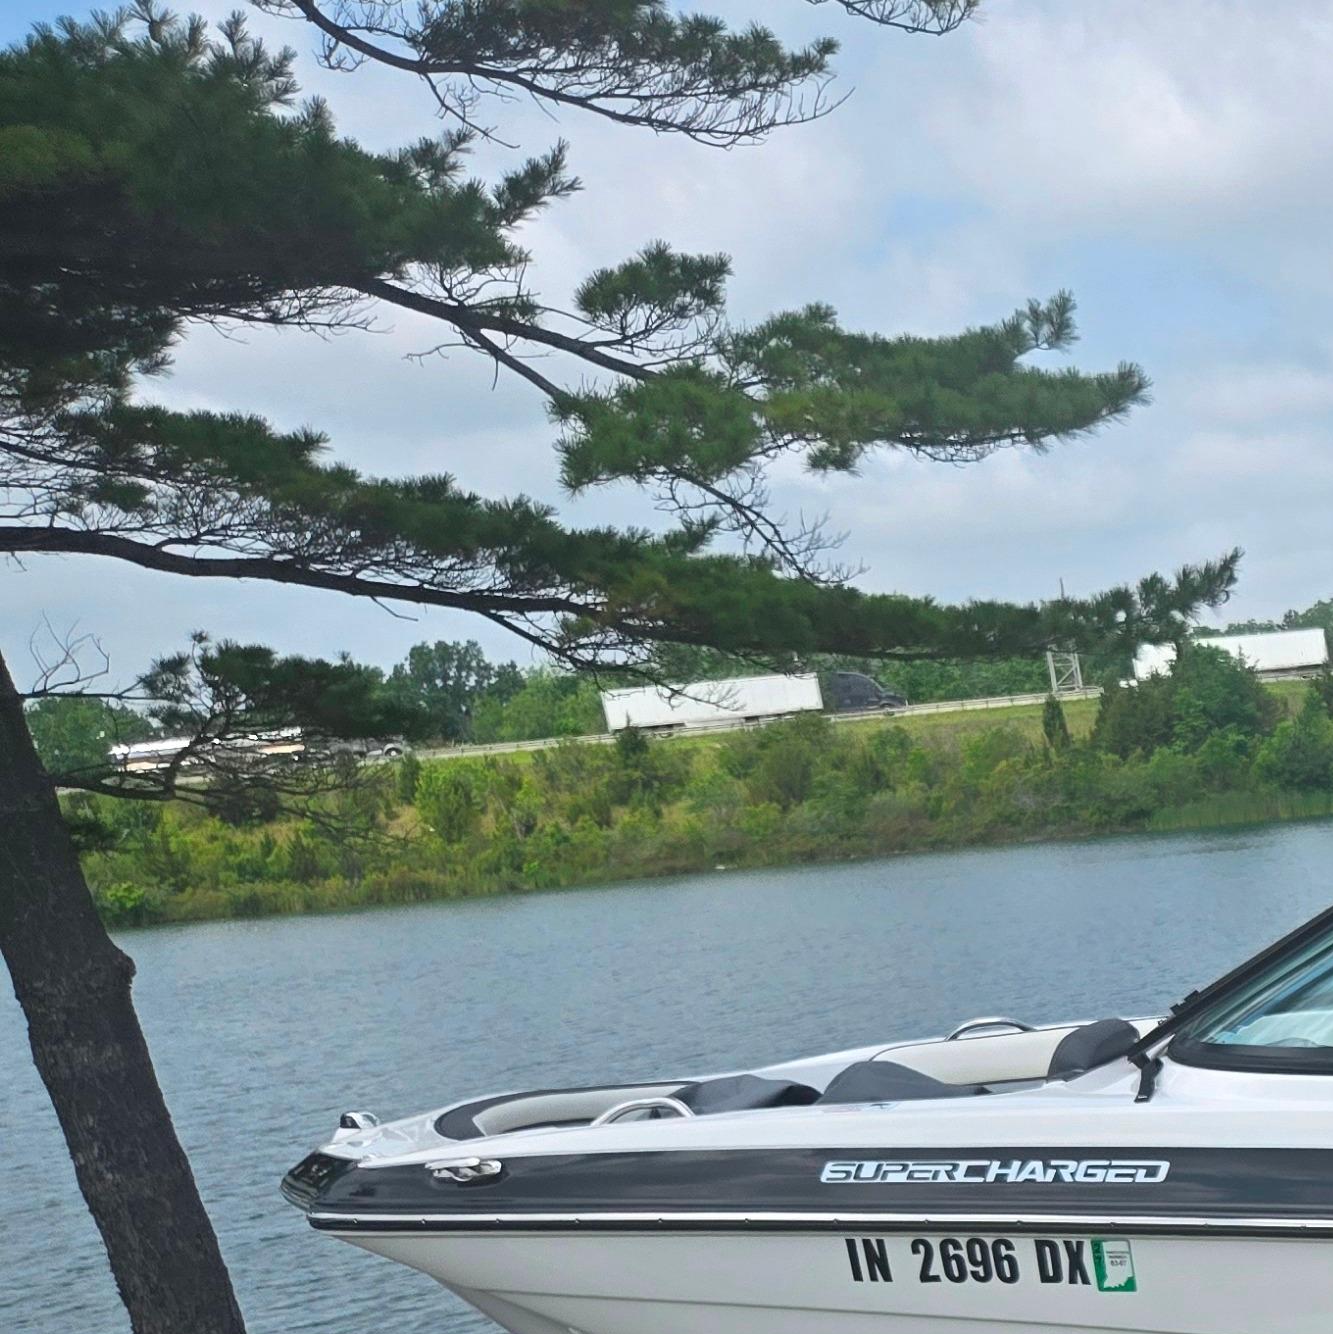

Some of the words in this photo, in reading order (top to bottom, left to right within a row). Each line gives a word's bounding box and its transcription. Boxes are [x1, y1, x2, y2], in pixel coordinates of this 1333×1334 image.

[820, 1160, 1171, 1184] SUPERCHARGED
[845, 1238, 893, 1283] IN
[911, 1238, 1020, 1284] 2696
[1034, 1239, 1091, 1285] DX
